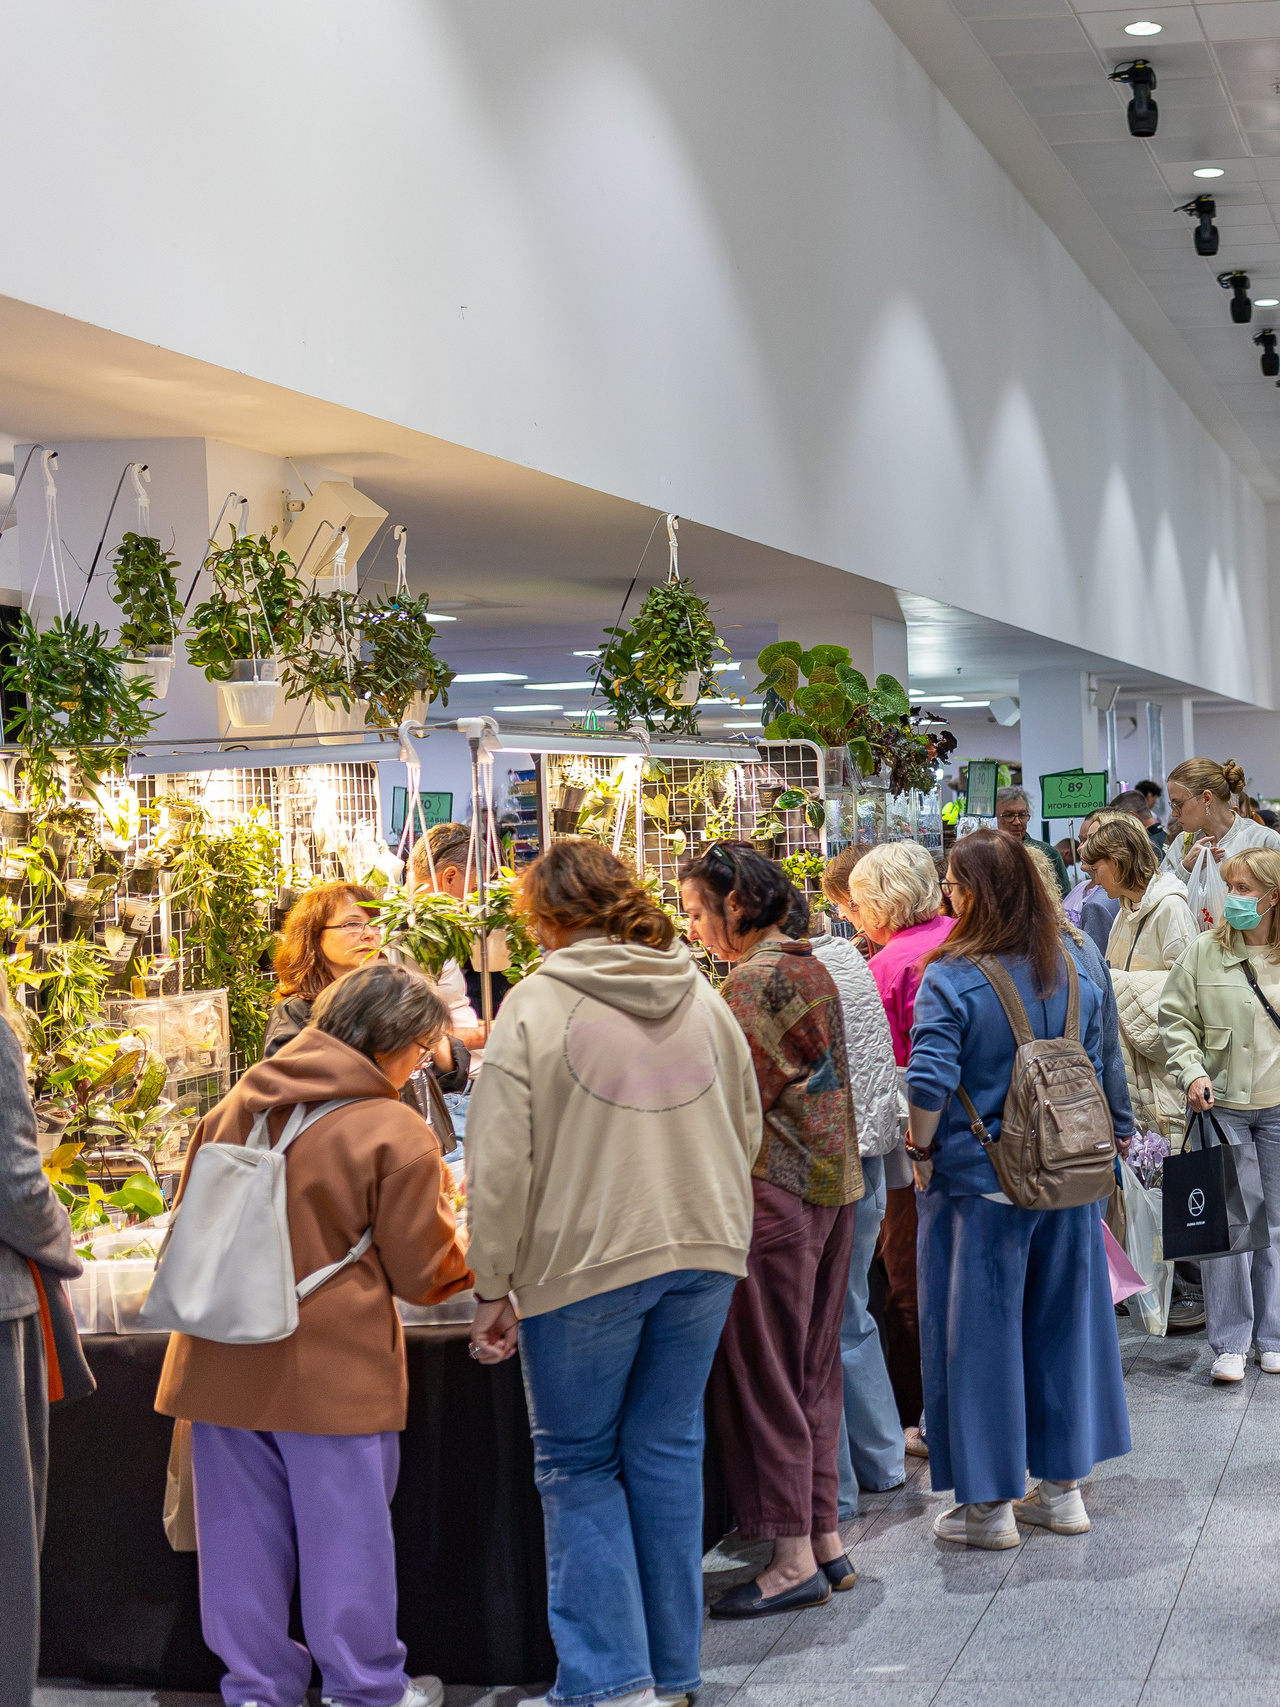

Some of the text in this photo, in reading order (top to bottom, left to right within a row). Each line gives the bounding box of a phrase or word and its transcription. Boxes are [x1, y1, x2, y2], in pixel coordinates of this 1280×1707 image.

[1068, 782, 1083, 793] 89
[1047, 801, 1104, 810] ИГОРЬ ЕГОРОВ
